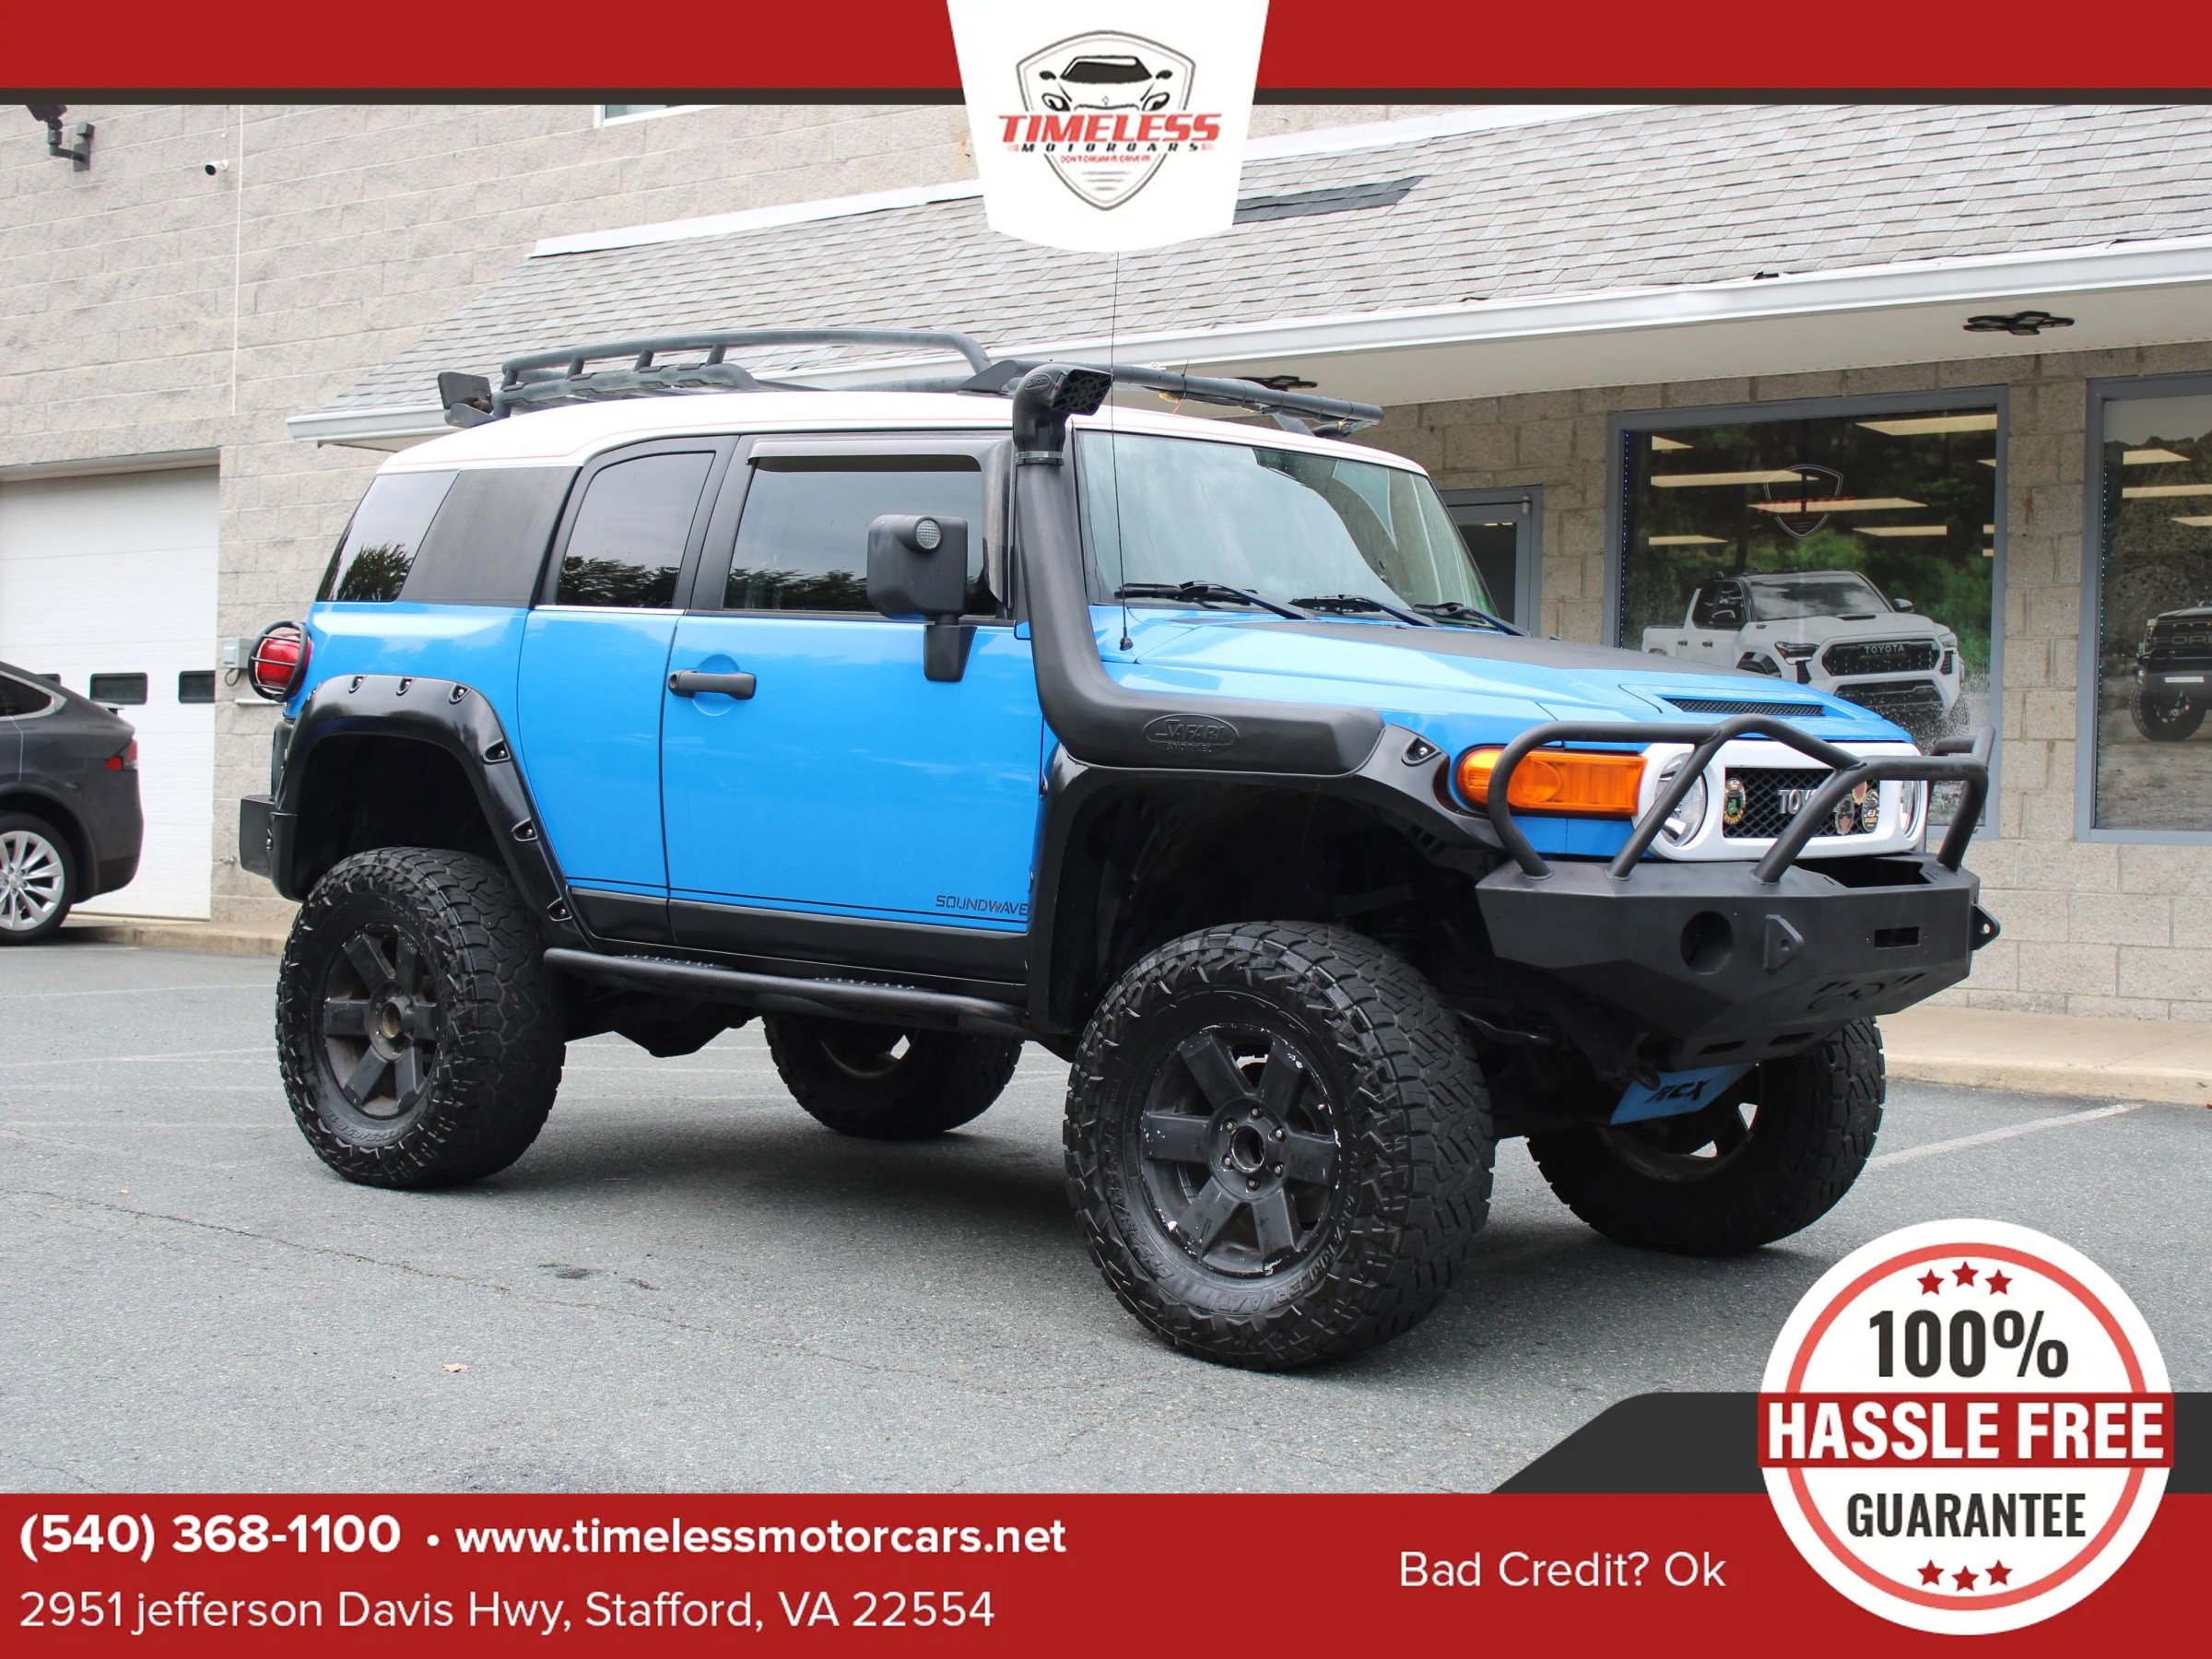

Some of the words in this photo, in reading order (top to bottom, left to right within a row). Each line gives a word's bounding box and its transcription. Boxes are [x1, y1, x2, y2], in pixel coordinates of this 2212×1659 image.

[2151, 634, 2212, 646] FOR
[1865, 644, 1905, 654] TOYOTA
[1155, 719, 1226, 740] SAFARI
[935, 894, 1029, 917] SOUNDWAVE
